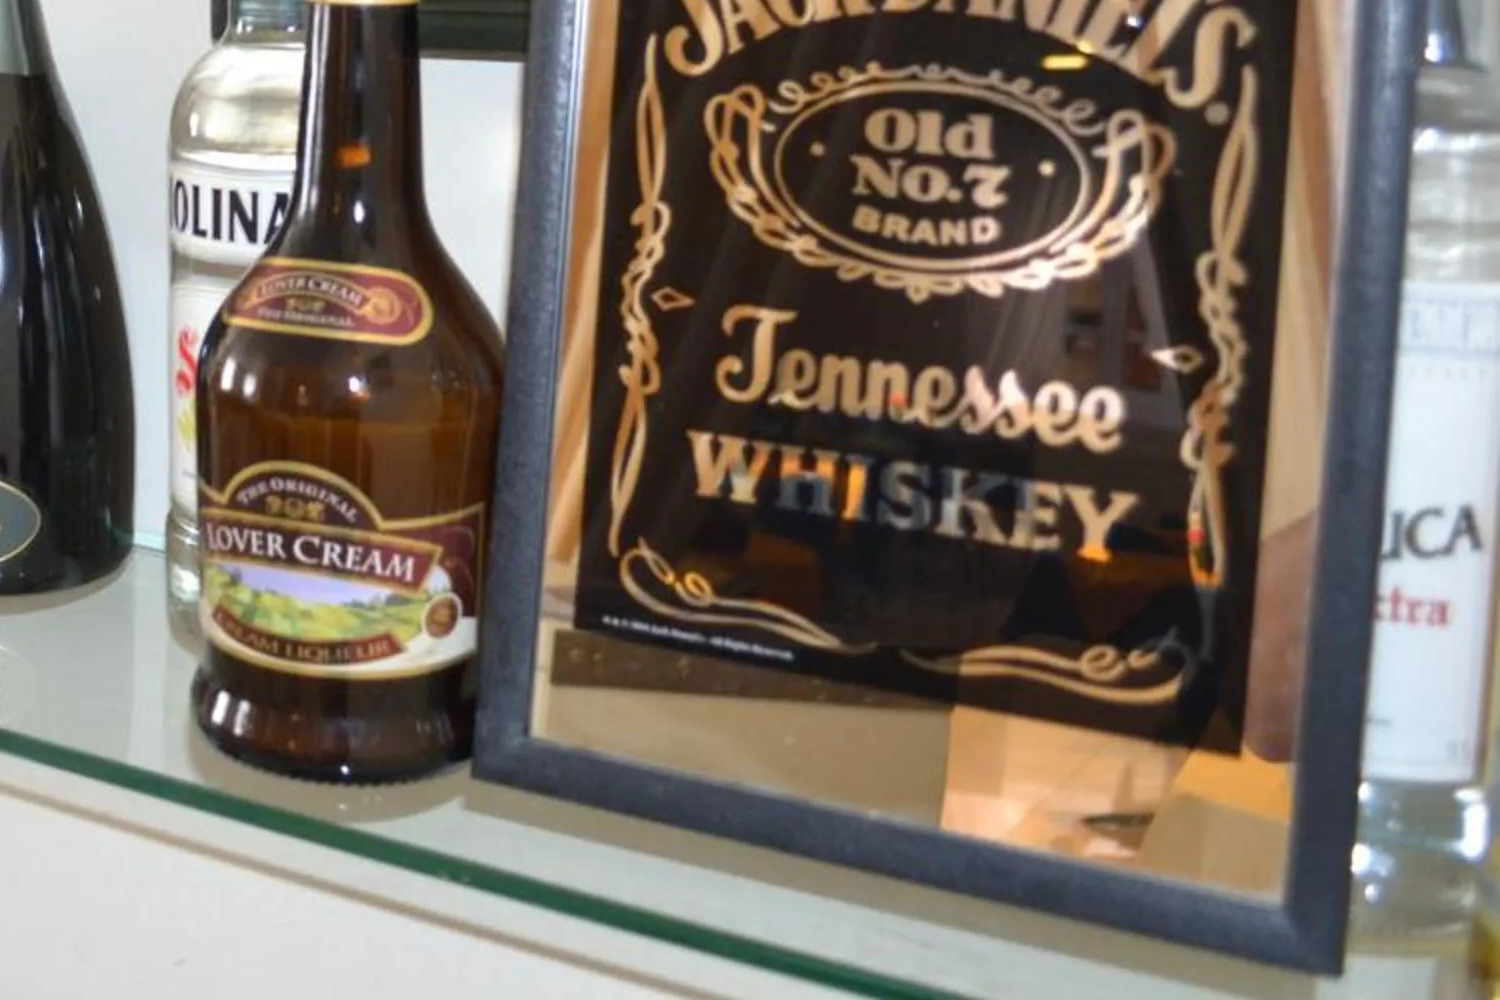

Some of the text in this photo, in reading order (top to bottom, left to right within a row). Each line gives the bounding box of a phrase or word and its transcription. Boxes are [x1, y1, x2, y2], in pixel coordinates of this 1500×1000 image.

[865, 107, 996, 159] Old
[170, 175, 289, 246] OLINA
[852, 203, 1002, 246] BRAND
[307, 277, 363, 306] CREAM
[715, 304, 1127, 454] Tennessee
[237, 476, 358, 523] THE ORIGINAL
[686, 429, 1140, 563] WHISKEY
[292, 534, 416, 583] CREAM
